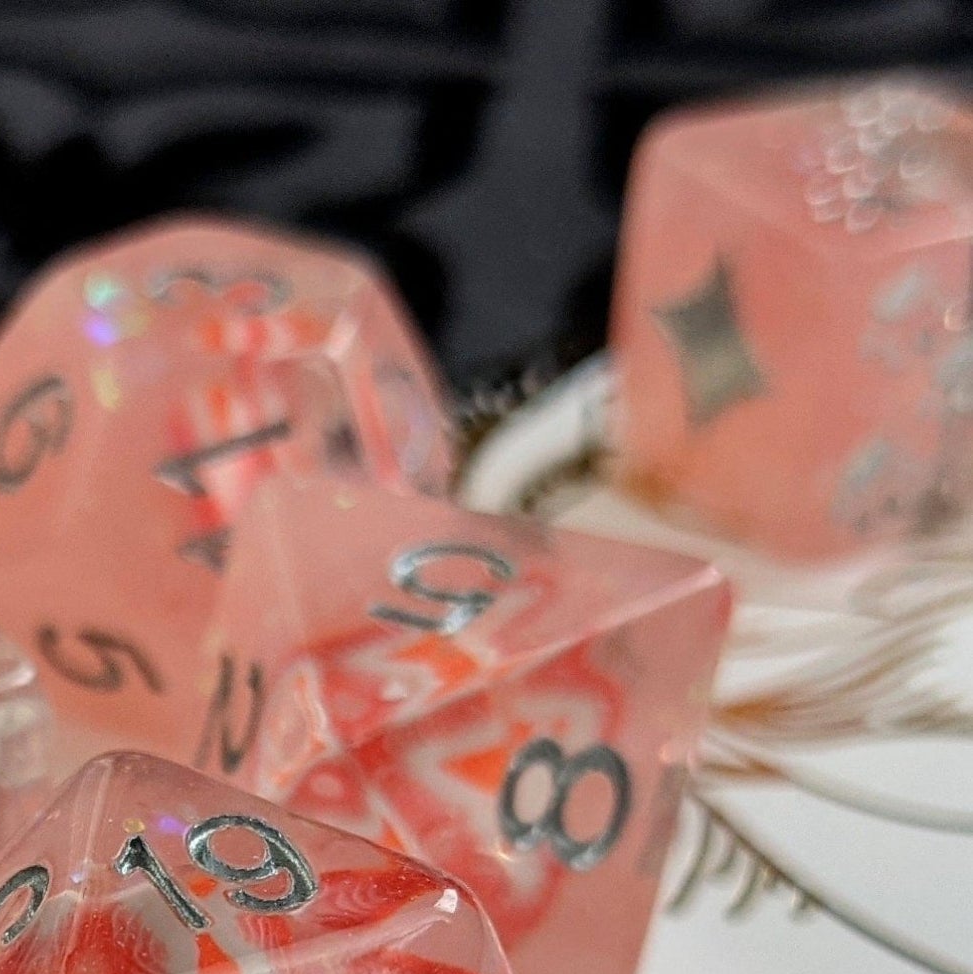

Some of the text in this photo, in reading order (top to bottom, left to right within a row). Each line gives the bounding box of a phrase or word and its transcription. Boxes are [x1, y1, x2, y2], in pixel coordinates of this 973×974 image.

[369, 544, 515, 635] 5
[38, 622, 166, 695] 5
[498, 737, 632, 870] 8
[114, 815, 317, 930] 19
